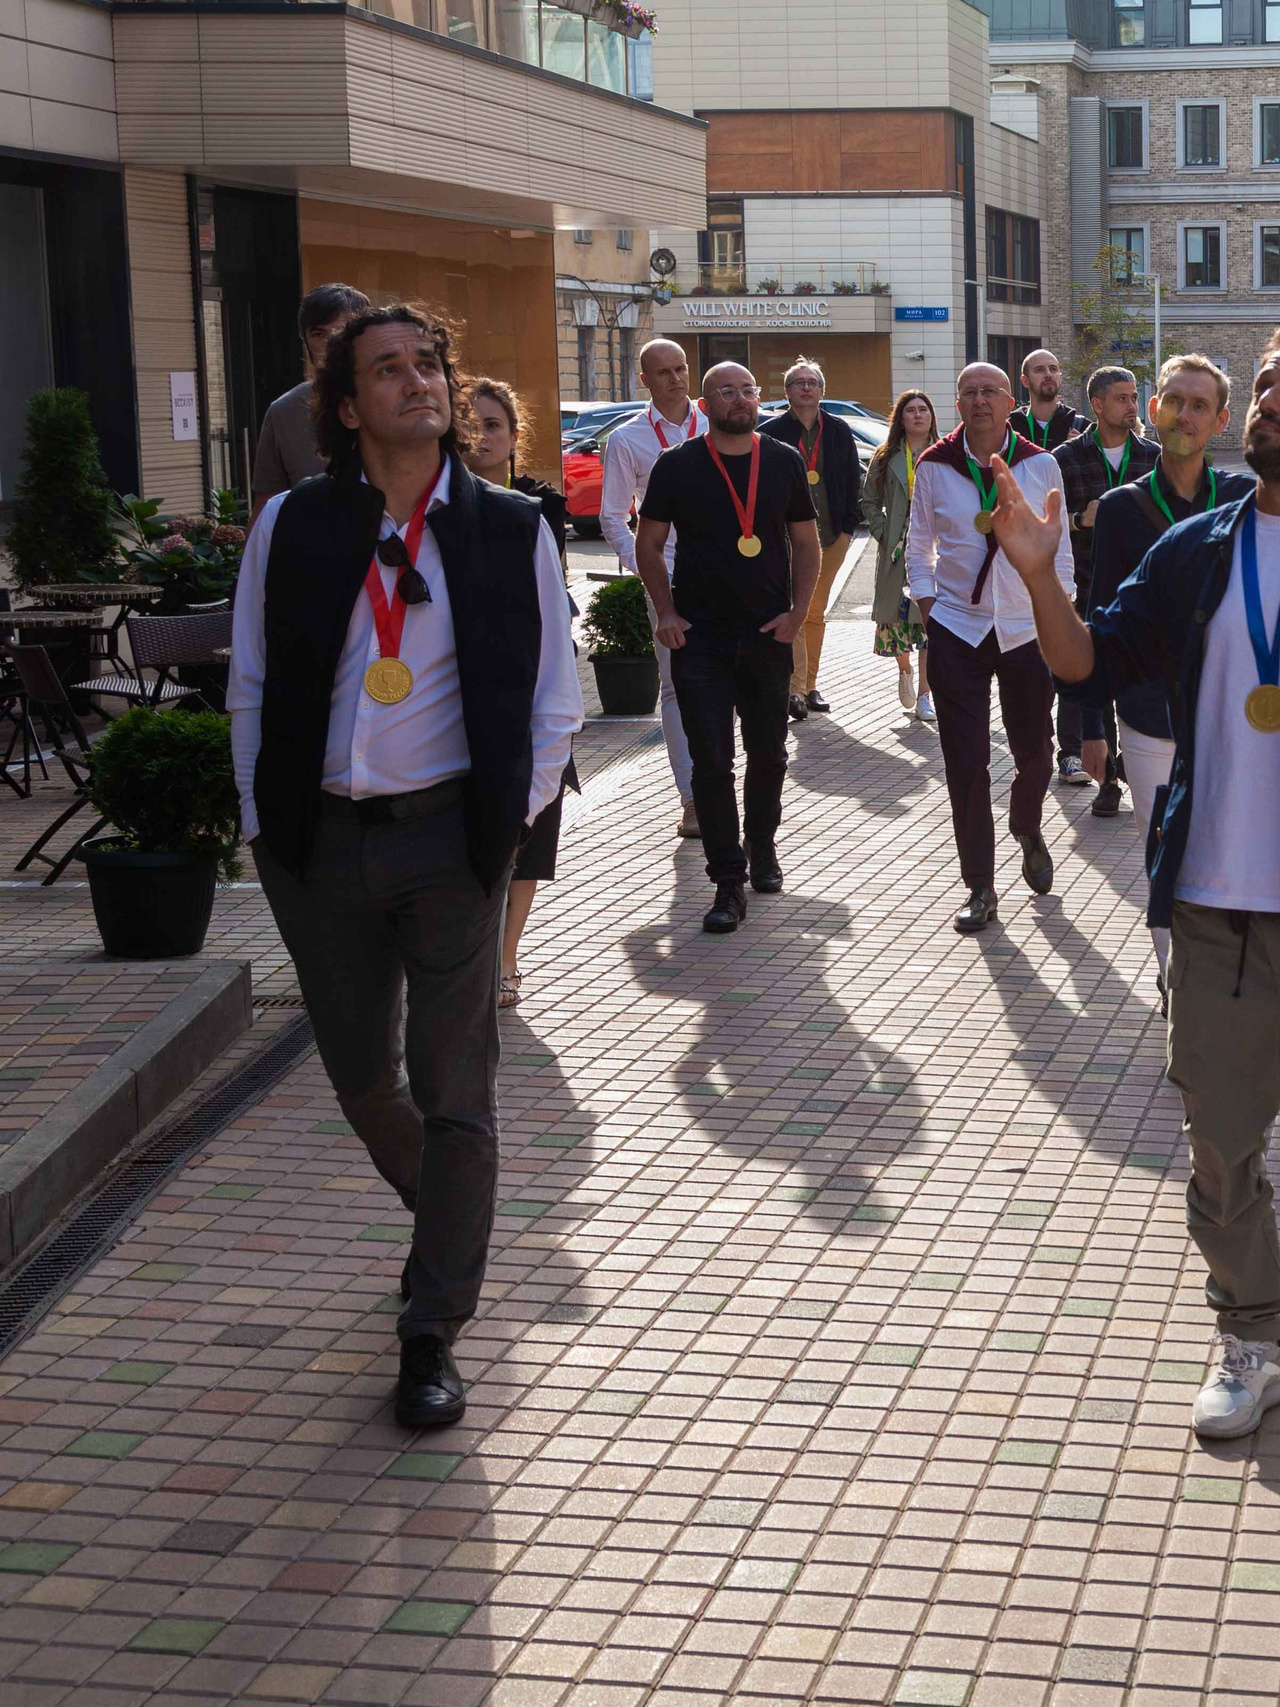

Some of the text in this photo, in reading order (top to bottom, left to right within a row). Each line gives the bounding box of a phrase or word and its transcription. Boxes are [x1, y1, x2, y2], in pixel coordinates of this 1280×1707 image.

[682, 302, 829, 316] WILL WHITE CLINIC
